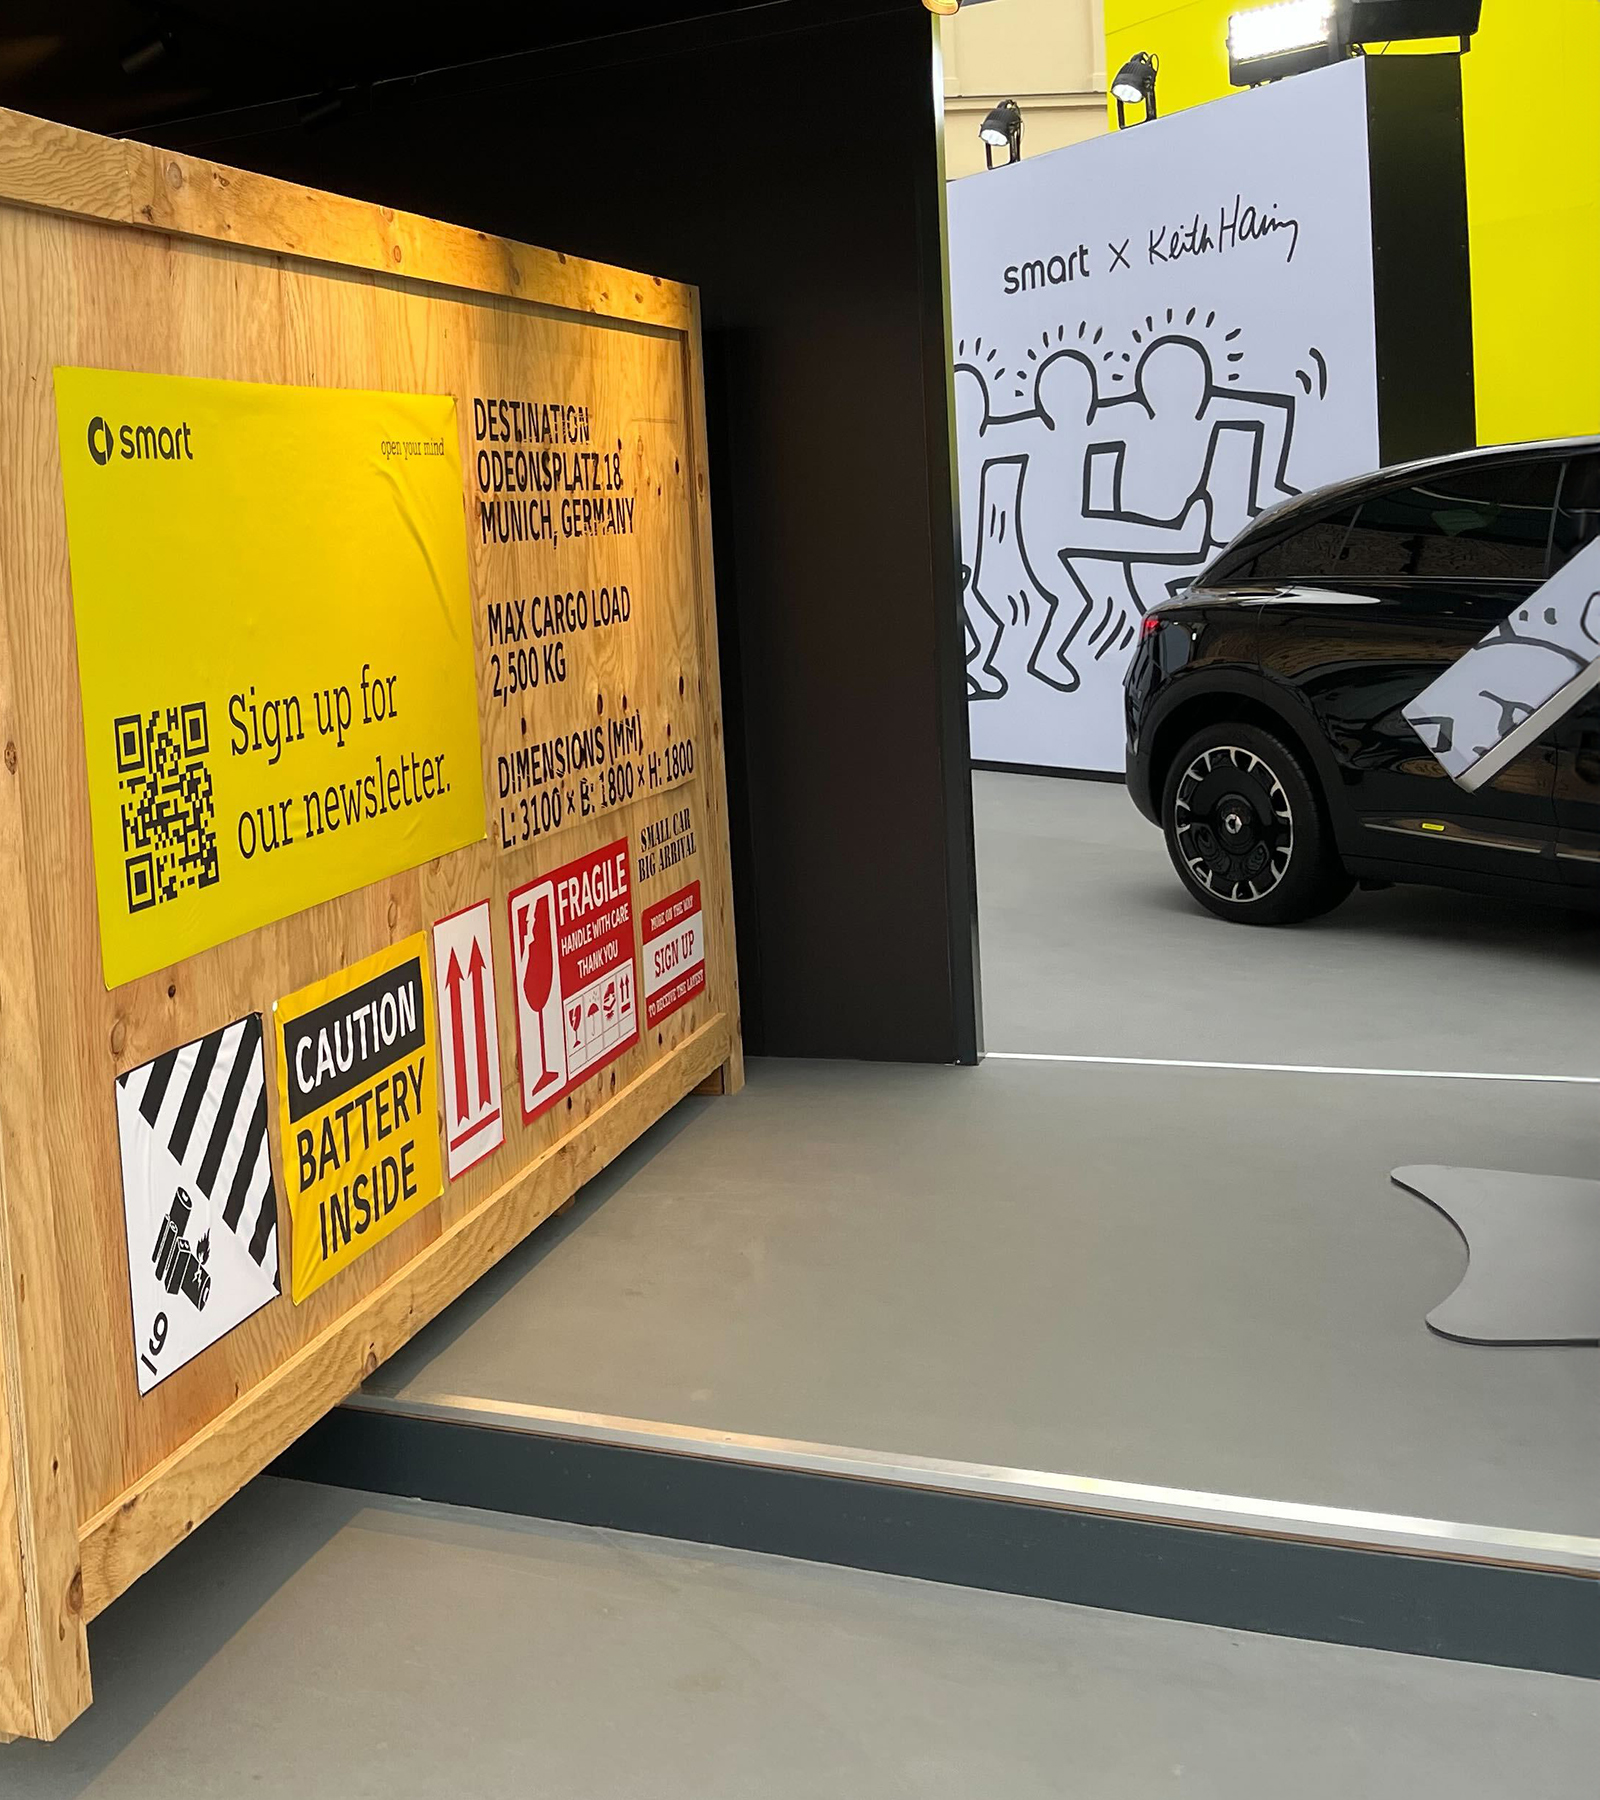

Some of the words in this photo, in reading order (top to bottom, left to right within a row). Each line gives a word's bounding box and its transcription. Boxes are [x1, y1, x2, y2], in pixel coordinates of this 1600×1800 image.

[1003, 244, 1090, 294] smart
[1148, 213, 1214, 265] Keith
[119, 421, 193, 461] smart
[380, 440, 402, 460] open
[402, 441, 421, 460] your
[423, 437, 445, 456] mind
[473, 397, 590, 445] DESTINATION
[477, 449, 601, 493] ODEONSPLATZ
[603, 452, 622, 490] 18
[480, 499, 558, 550] MUNICH,
[561, 497, 635, 538] GERMANY
[487, 599, 528, 647] MAX
[531, 590, 588, 639] CARGO
[591, 585, 631, 628] LOAD
[490, 646, 539, 707] 2,500
[542, 641, 566, 685] KG
[227, 686, 305, 766] Sign
[313, 685, 352, 748] up
[360, 663, 398, 724] for
[497, 725, 605, 799] DIMENSIONS
[608, 709, 643, 765] (MM)
[237, 797, 295, 860] our
[303, 751, 451, 839] newsletter.
[500, 807, 516, 850] L:
[520, 787, 562, 841] 3100
[579, 777, 595, 817] B:
[598, 761, 634, 809] 1800
[648, 751, 662, 790] H:
[664, 739, 694, 783] 1800
[638, 852, 656, 883] BIG
[658, 832, 697, 873] ARRIVAL
[640, 817, 671, 853] SMALL
[672, 807, 691, 836] CAR
[557, 852, 628, 927] FRAGILE
[560, 922, 593, 957] HANDLE
[591, 912, 612, 941] WITH
[610, 902, 630, 929] CARE
[577, 951, 604, 979] THANK
[603, 939, 619, 964] YOU
[654, 938, 680, 978] SIGN
[681, 929, 695, 960] UP
[294, 979, 417, 1094] CAUTION
[295, 1057, 427, 1193] BATTERY
[318, 1144, 418, 1262] INSIDE
